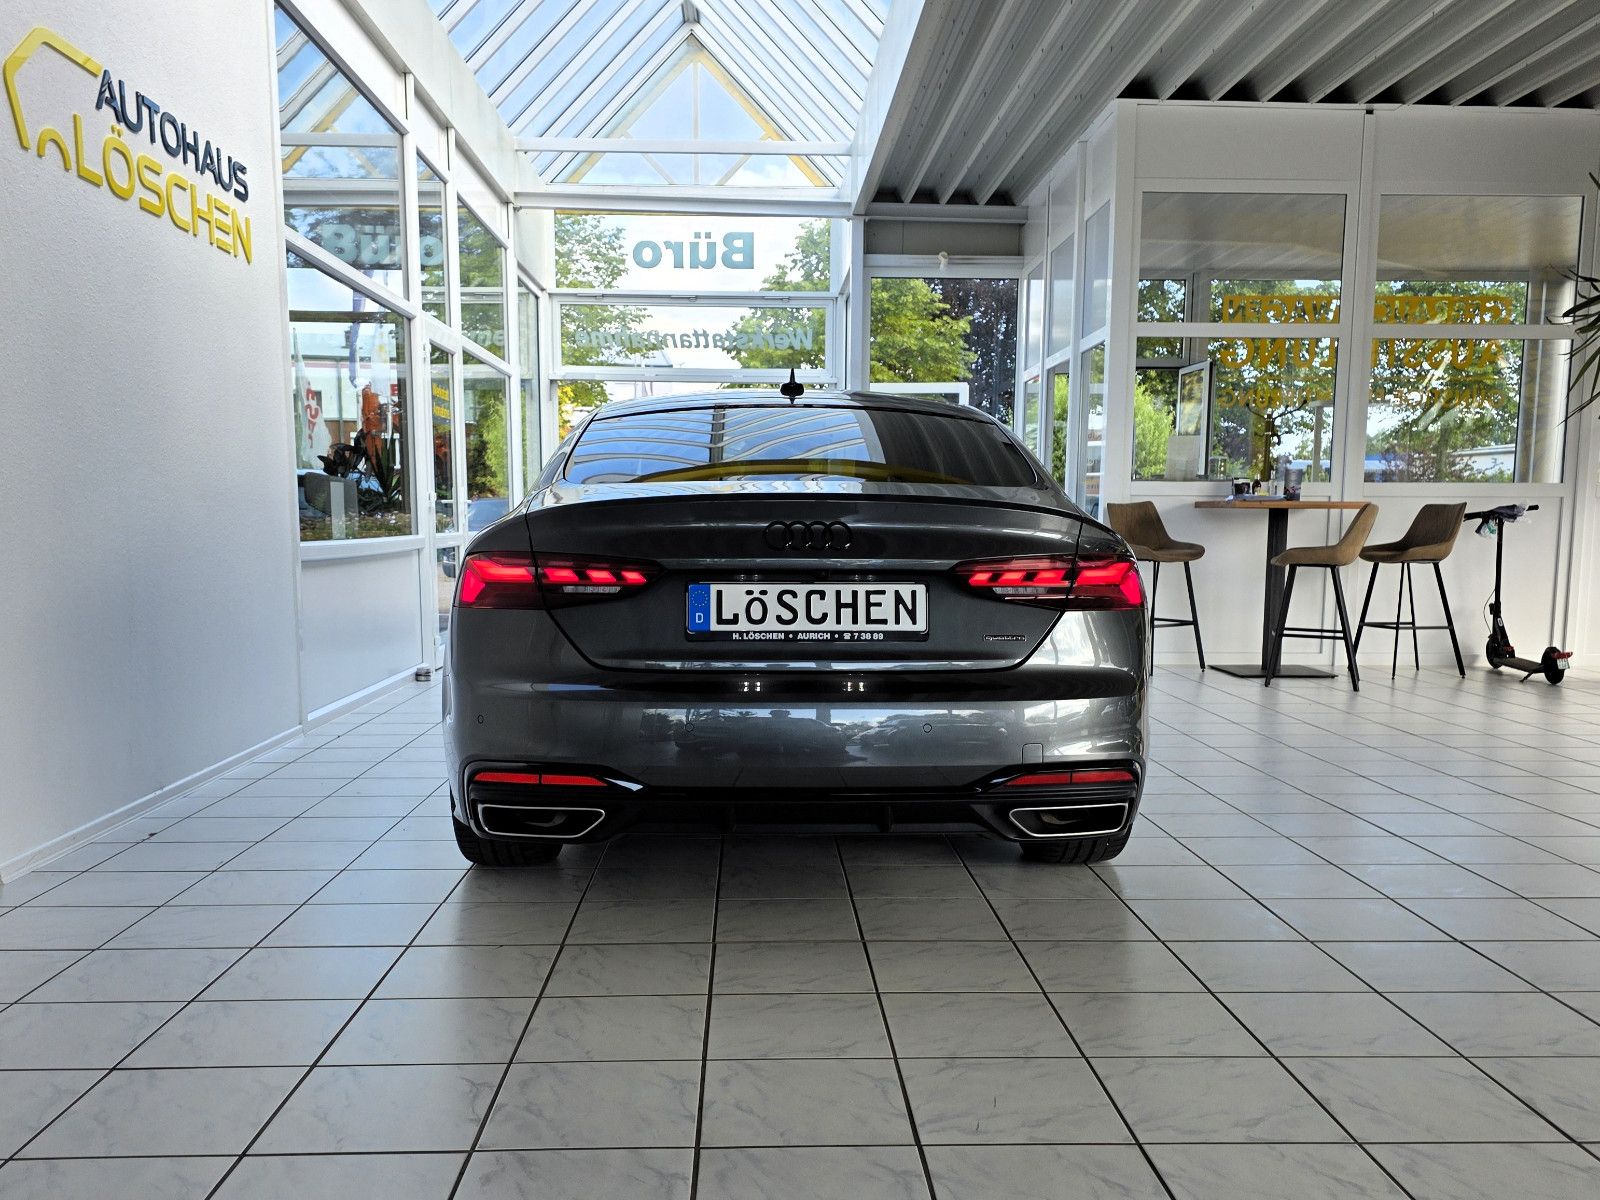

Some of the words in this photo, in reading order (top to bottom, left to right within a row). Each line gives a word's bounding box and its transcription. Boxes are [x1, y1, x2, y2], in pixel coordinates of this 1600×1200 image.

[95, 69, 249, 202] AUTOHAUS
[73, 112, 252, 264] LÖSCHEN
[695, 612, 704, 624] D
[743, 631, 785, 640] LÖSCHEN
[797, 632, 831, 640] AURICH
